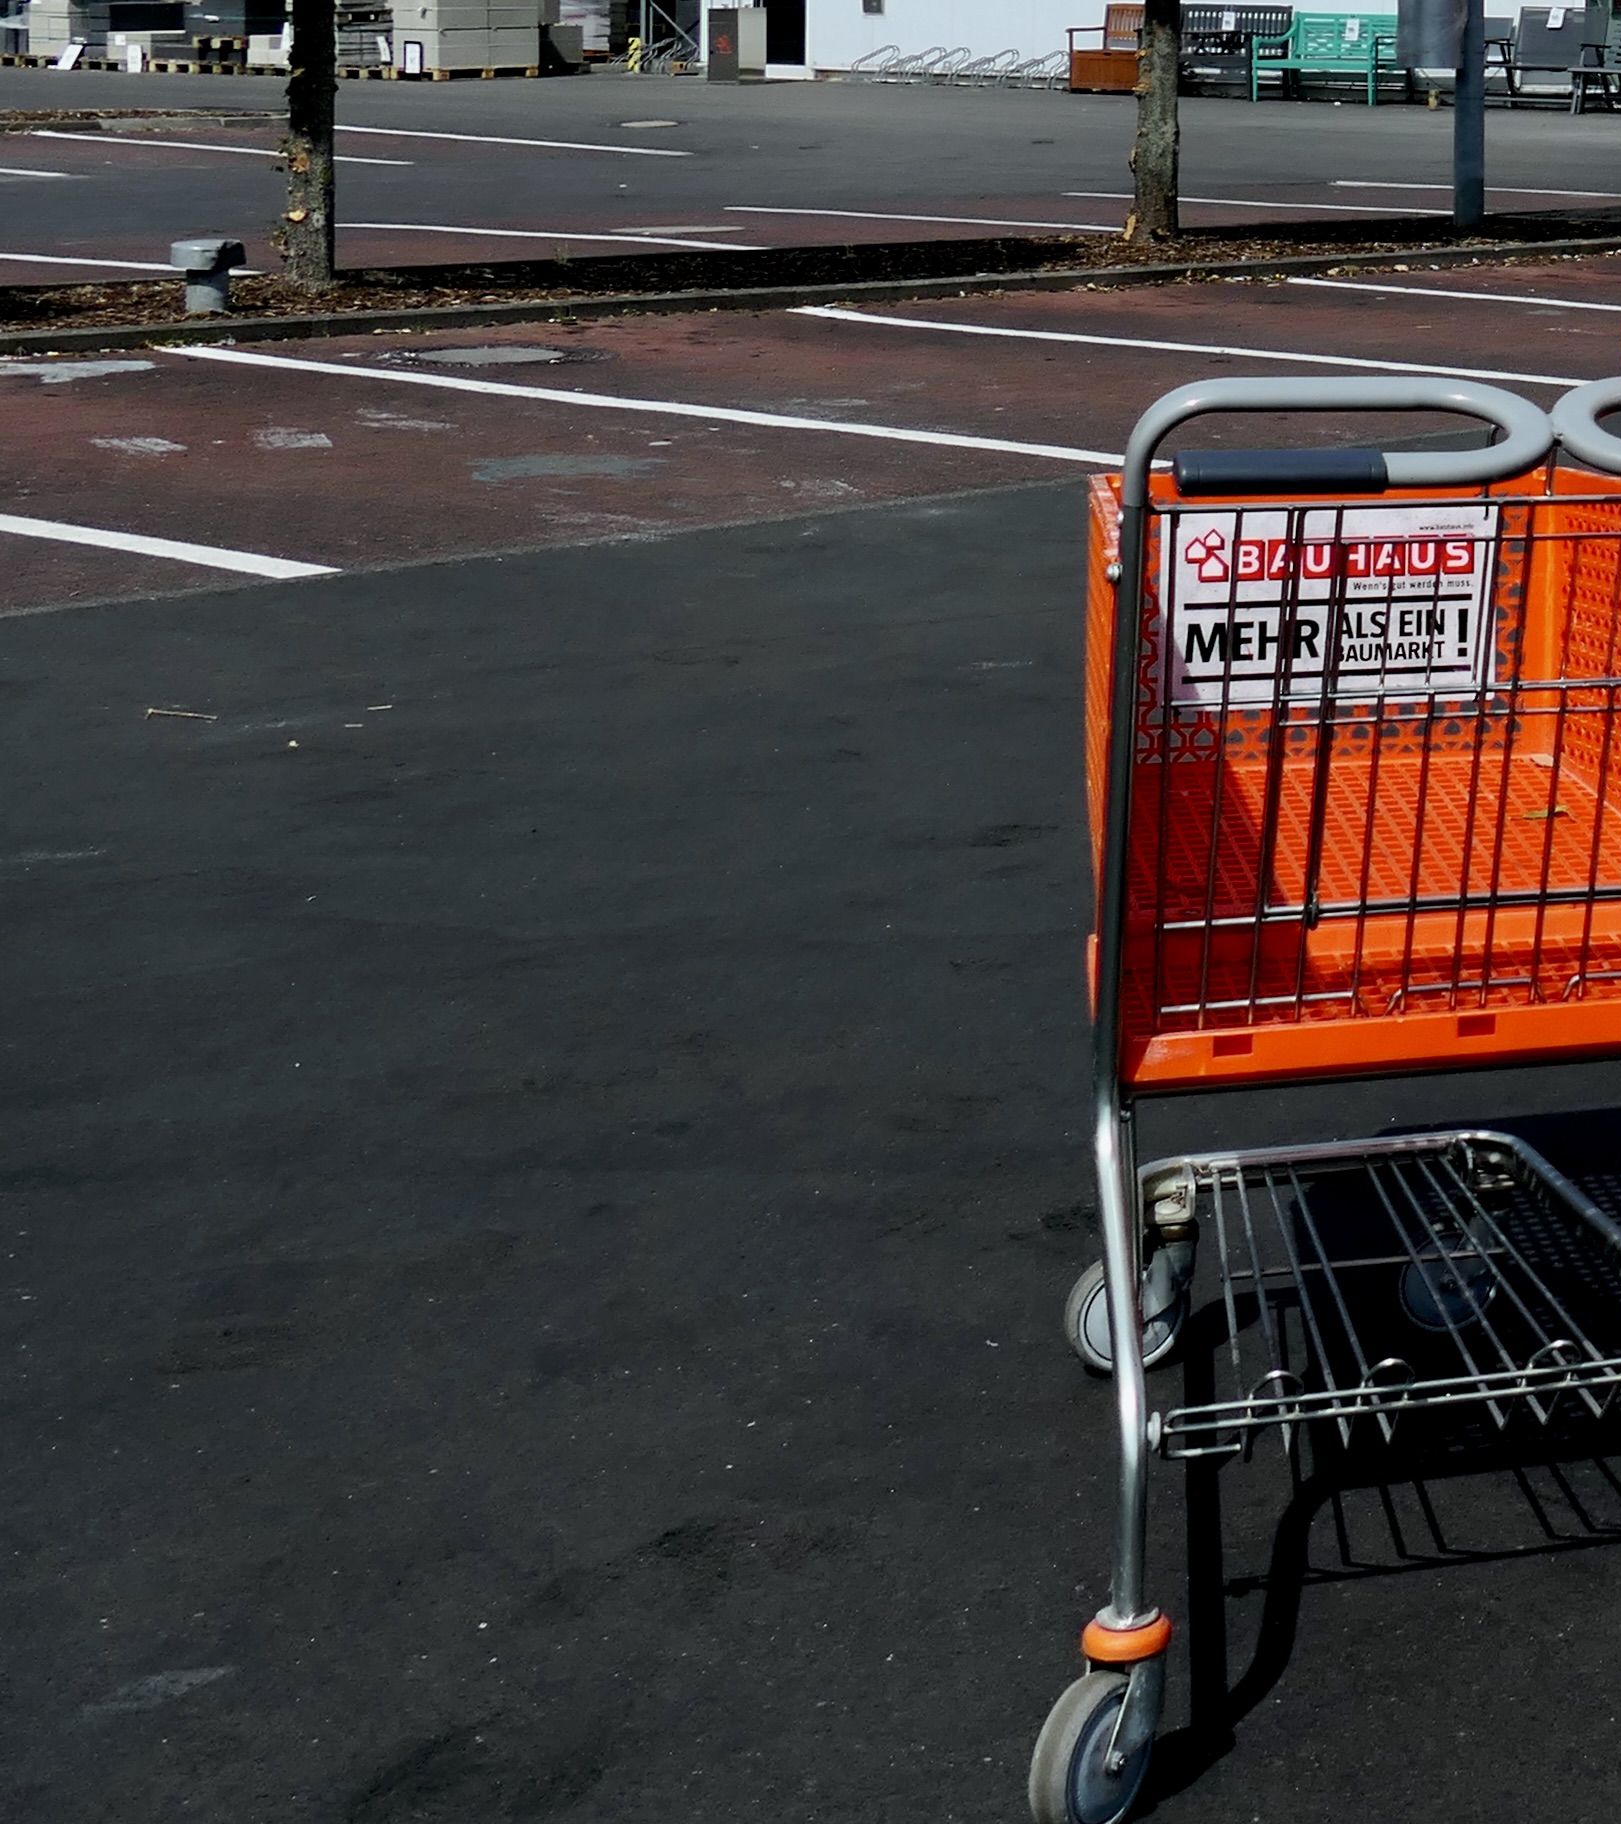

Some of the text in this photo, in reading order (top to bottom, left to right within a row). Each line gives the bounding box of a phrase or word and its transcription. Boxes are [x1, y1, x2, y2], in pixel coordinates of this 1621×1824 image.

[1237, 542, 1470, 575] BAUHAUS
[1353, 581, 1387, 591] Wenn's
[1447, 579, 1474, 588] muss.
[1340, 609, 1445, 639] ALS EIN
[1184, 619, 1320, 664] MEHR
